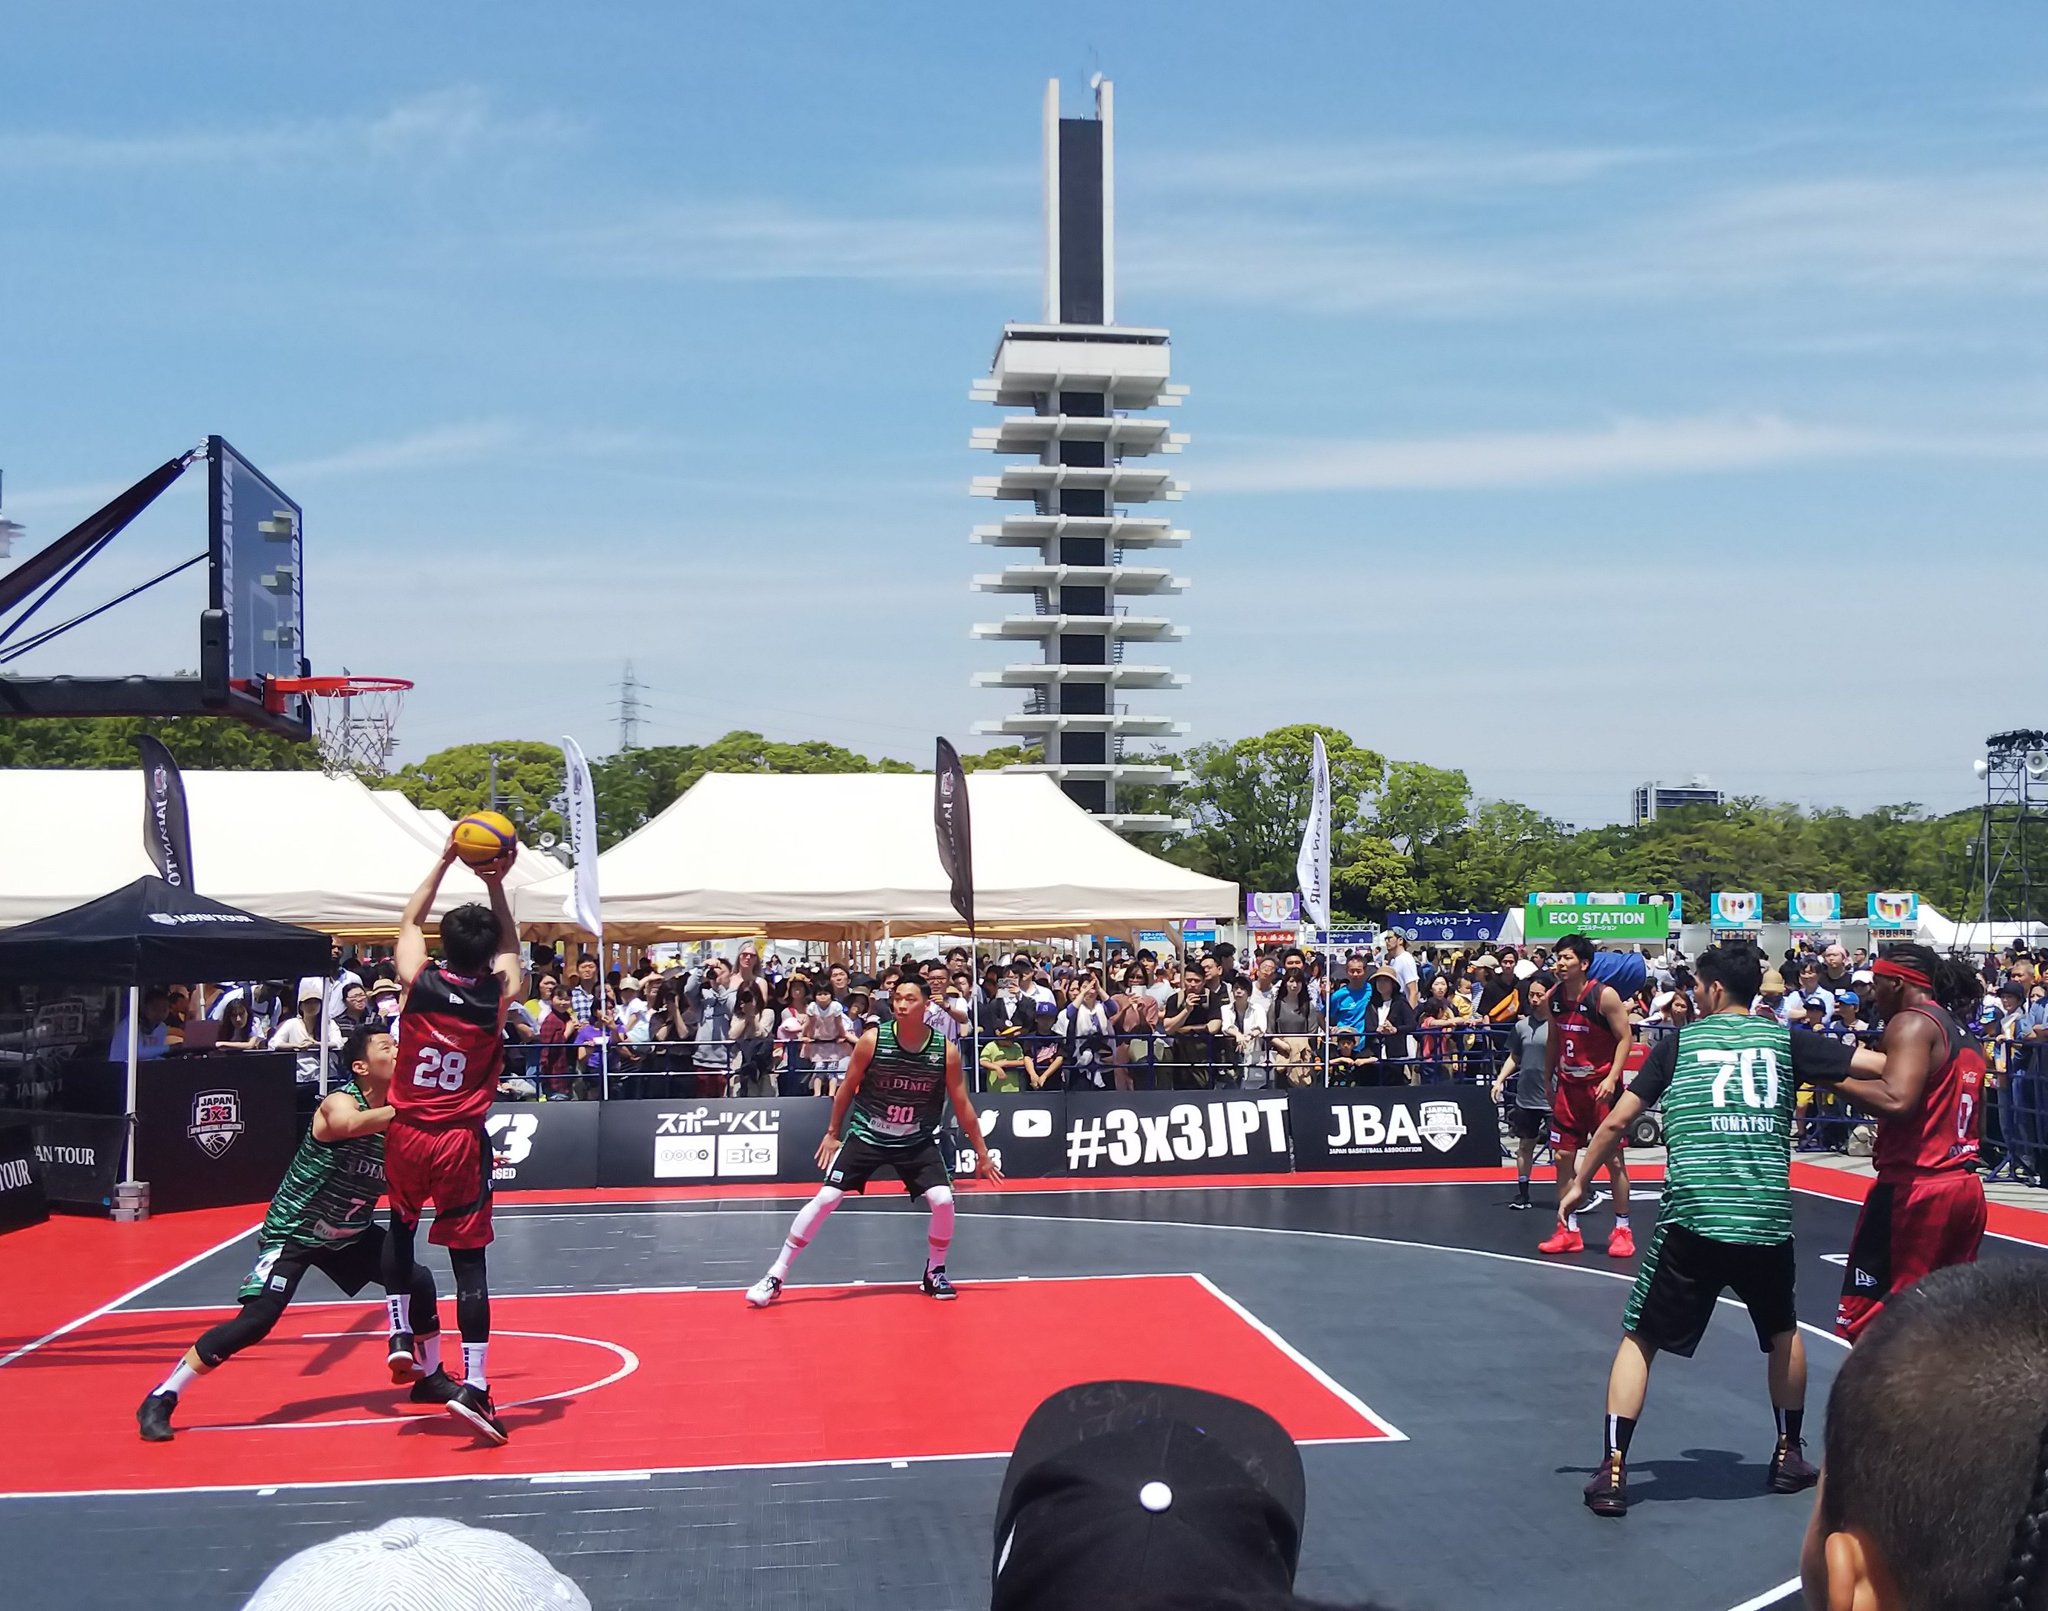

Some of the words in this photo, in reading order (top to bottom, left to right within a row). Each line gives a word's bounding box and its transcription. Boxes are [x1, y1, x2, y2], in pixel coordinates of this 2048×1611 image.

[173, 913, 217, 924] JAPAN
[1415, 916, 1481, 926] おみやげコーナー
[1549, 912, 1579, 925] ECO
[1582, 912, 1645, 925] STATION
[1565, 1039, 1575, 1058] 2
[413, 1046, 467, 1091] 28
[1697, 1048, 1778, 1108] 70
[201, 1096, 233, 1106] JAPAN
[200, 1106, 232, 1121] 3x3
[656, 1107, 780, 1134] スポーツくじ
[887, 1105, 914, 1124] 90
[1957, 1093, 1974, 1138] 0
[1327, 1104, 1422, 1147] JBA
[1711, 1115, 1774, 1133] KOMATSU
[1066, 1098, 1289, 1170] #3x3JPT
[34, 1145, 54, 1162] AN
[54, 1146, 96, 1165] TOUR
[661, 1149, 709, 1161] toto
[345, 1198, 367, 1222] 7
